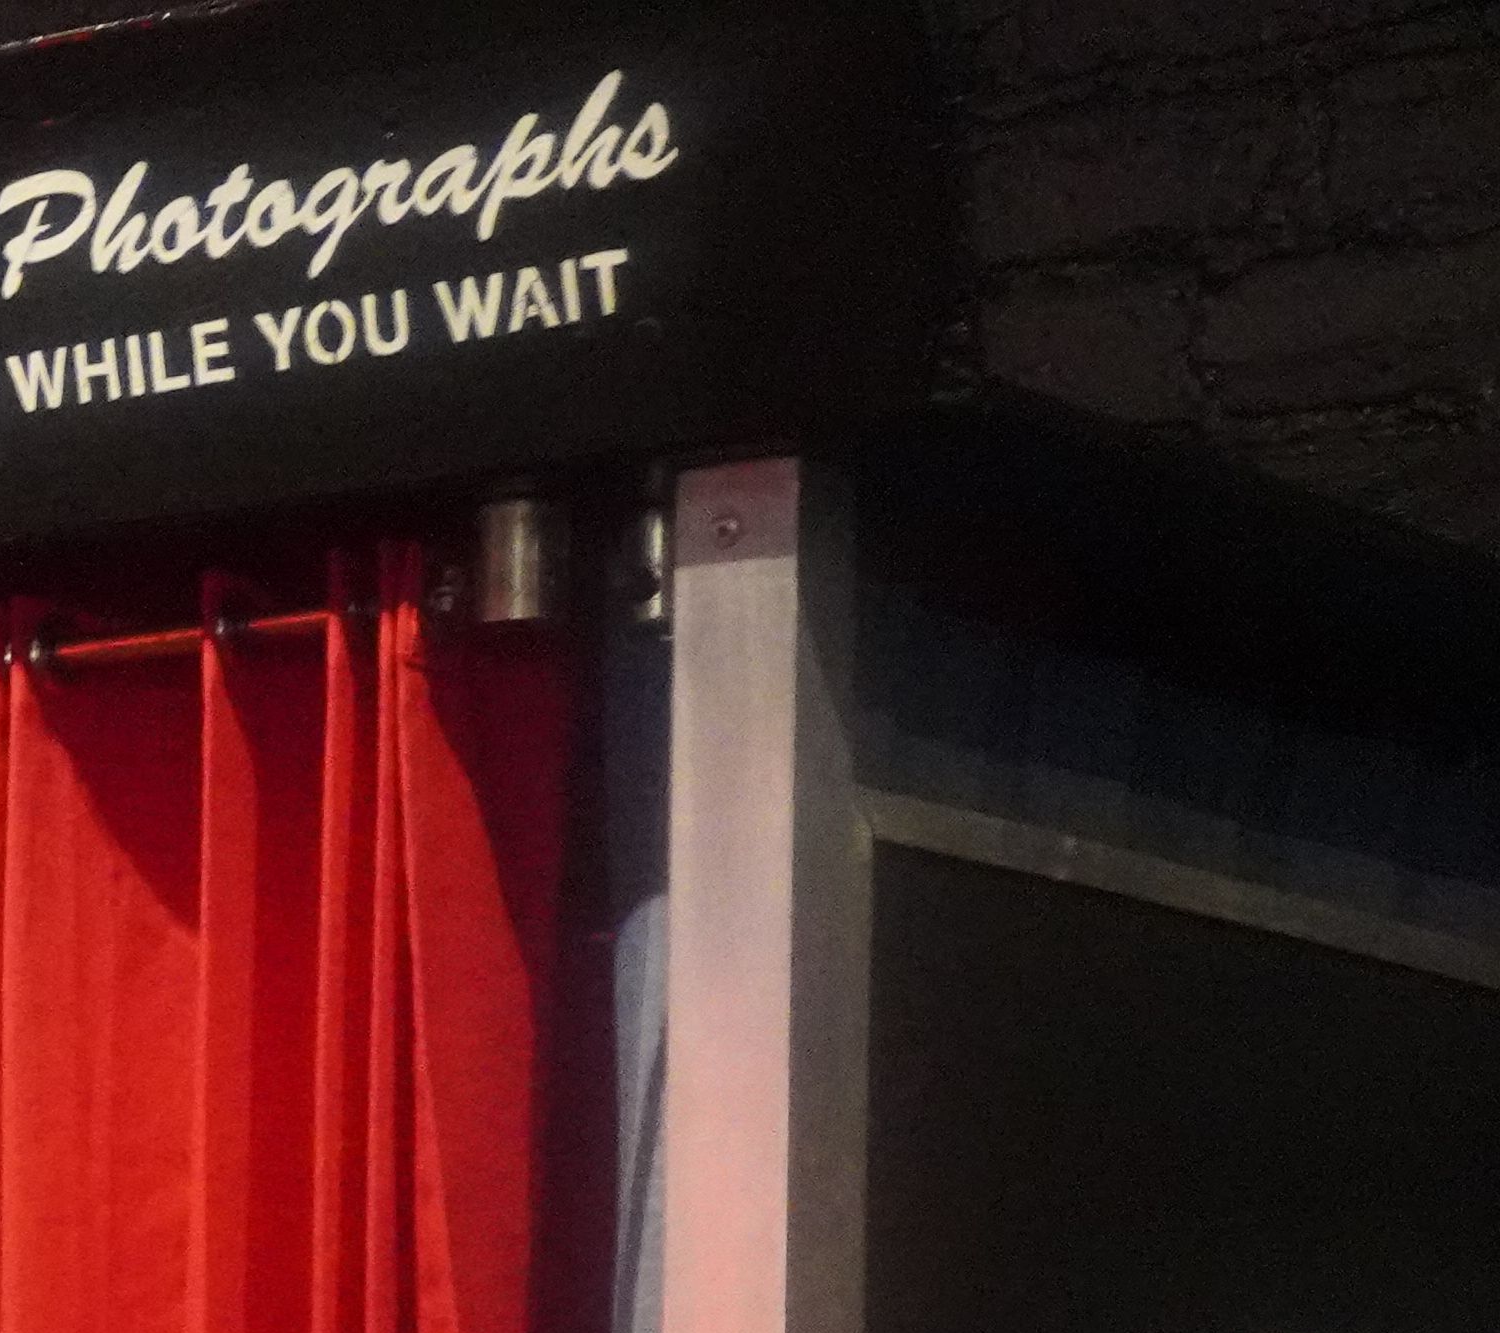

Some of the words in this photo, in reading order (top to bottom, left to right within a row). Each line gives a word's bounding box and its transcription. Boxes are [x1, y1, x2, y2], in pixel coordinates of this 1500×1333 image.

[5, 316, 235, 414] WHILE
[253, 286, 410, 380] YOU
[432, 247, 631, 344] WAIT
